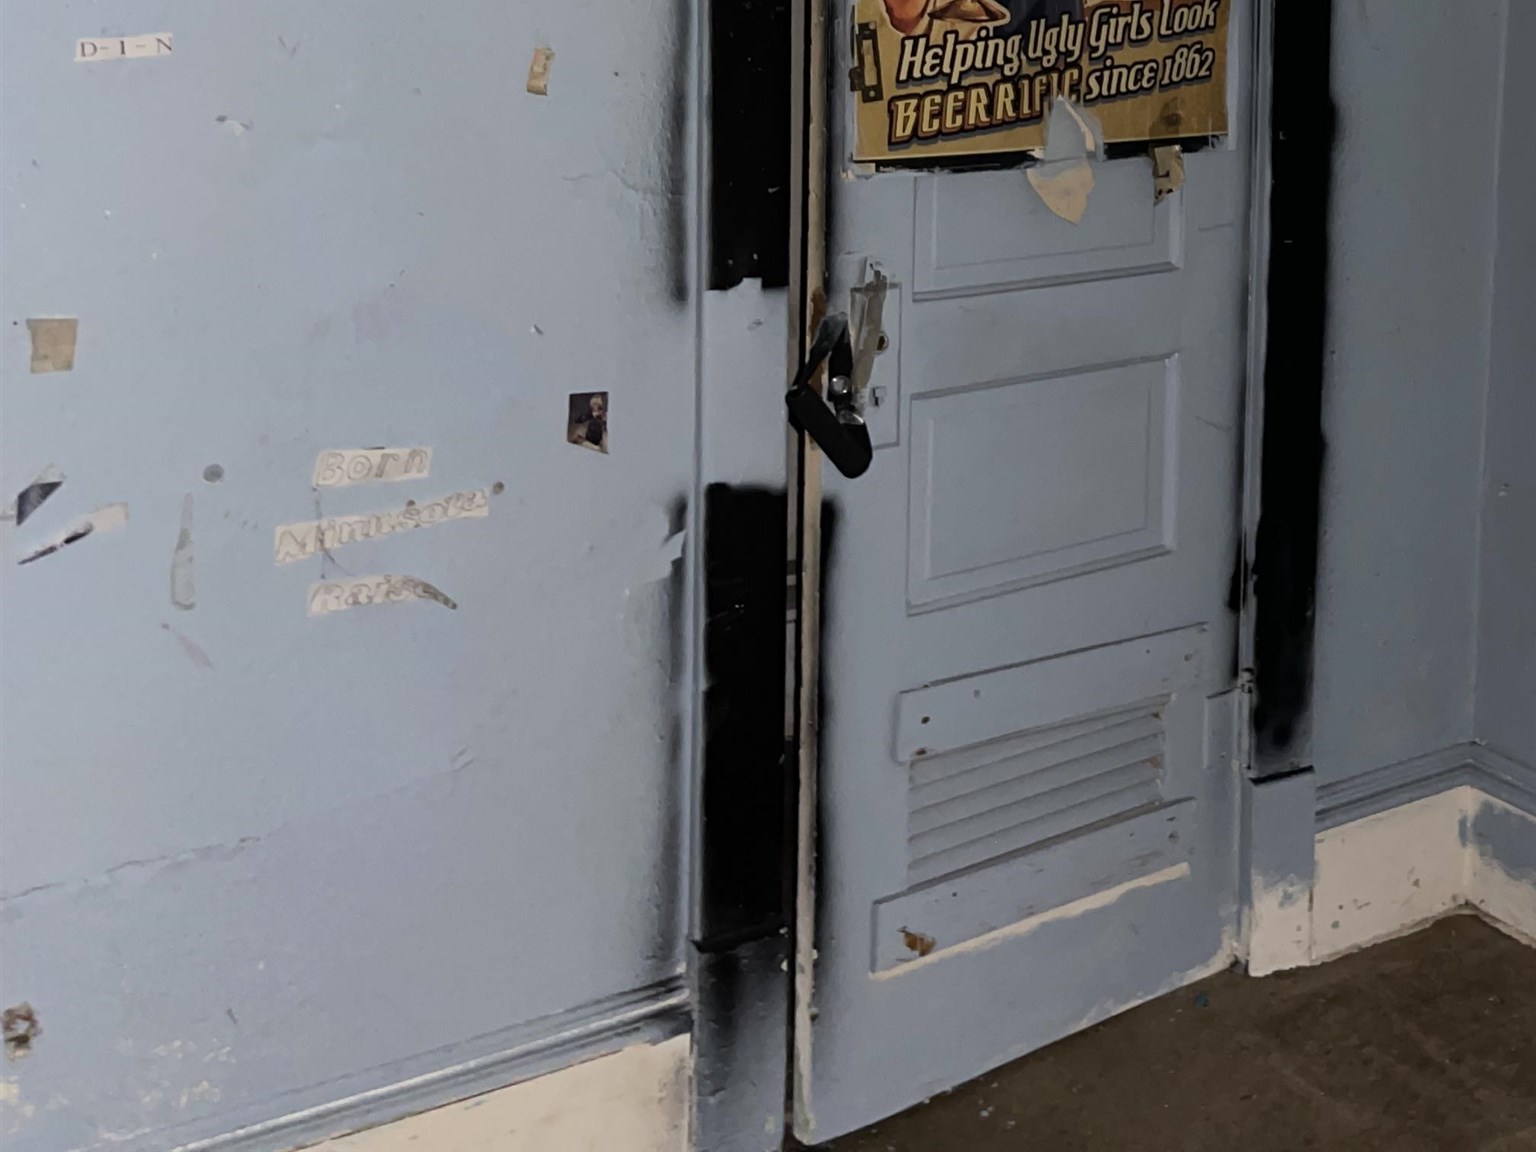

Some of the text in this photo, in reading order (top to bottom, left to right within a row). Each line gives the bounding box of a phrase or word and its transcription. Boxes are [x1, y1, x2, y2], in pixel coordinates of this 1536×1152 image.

[899, 24, 1022, 85] Helping
[1027, 13, 1084, 68] Ugly
[1087, 0, 1154, 57] Girls
[1085, 57, 1157, 102] since
[1160, 44, 1216, 88] 1862
